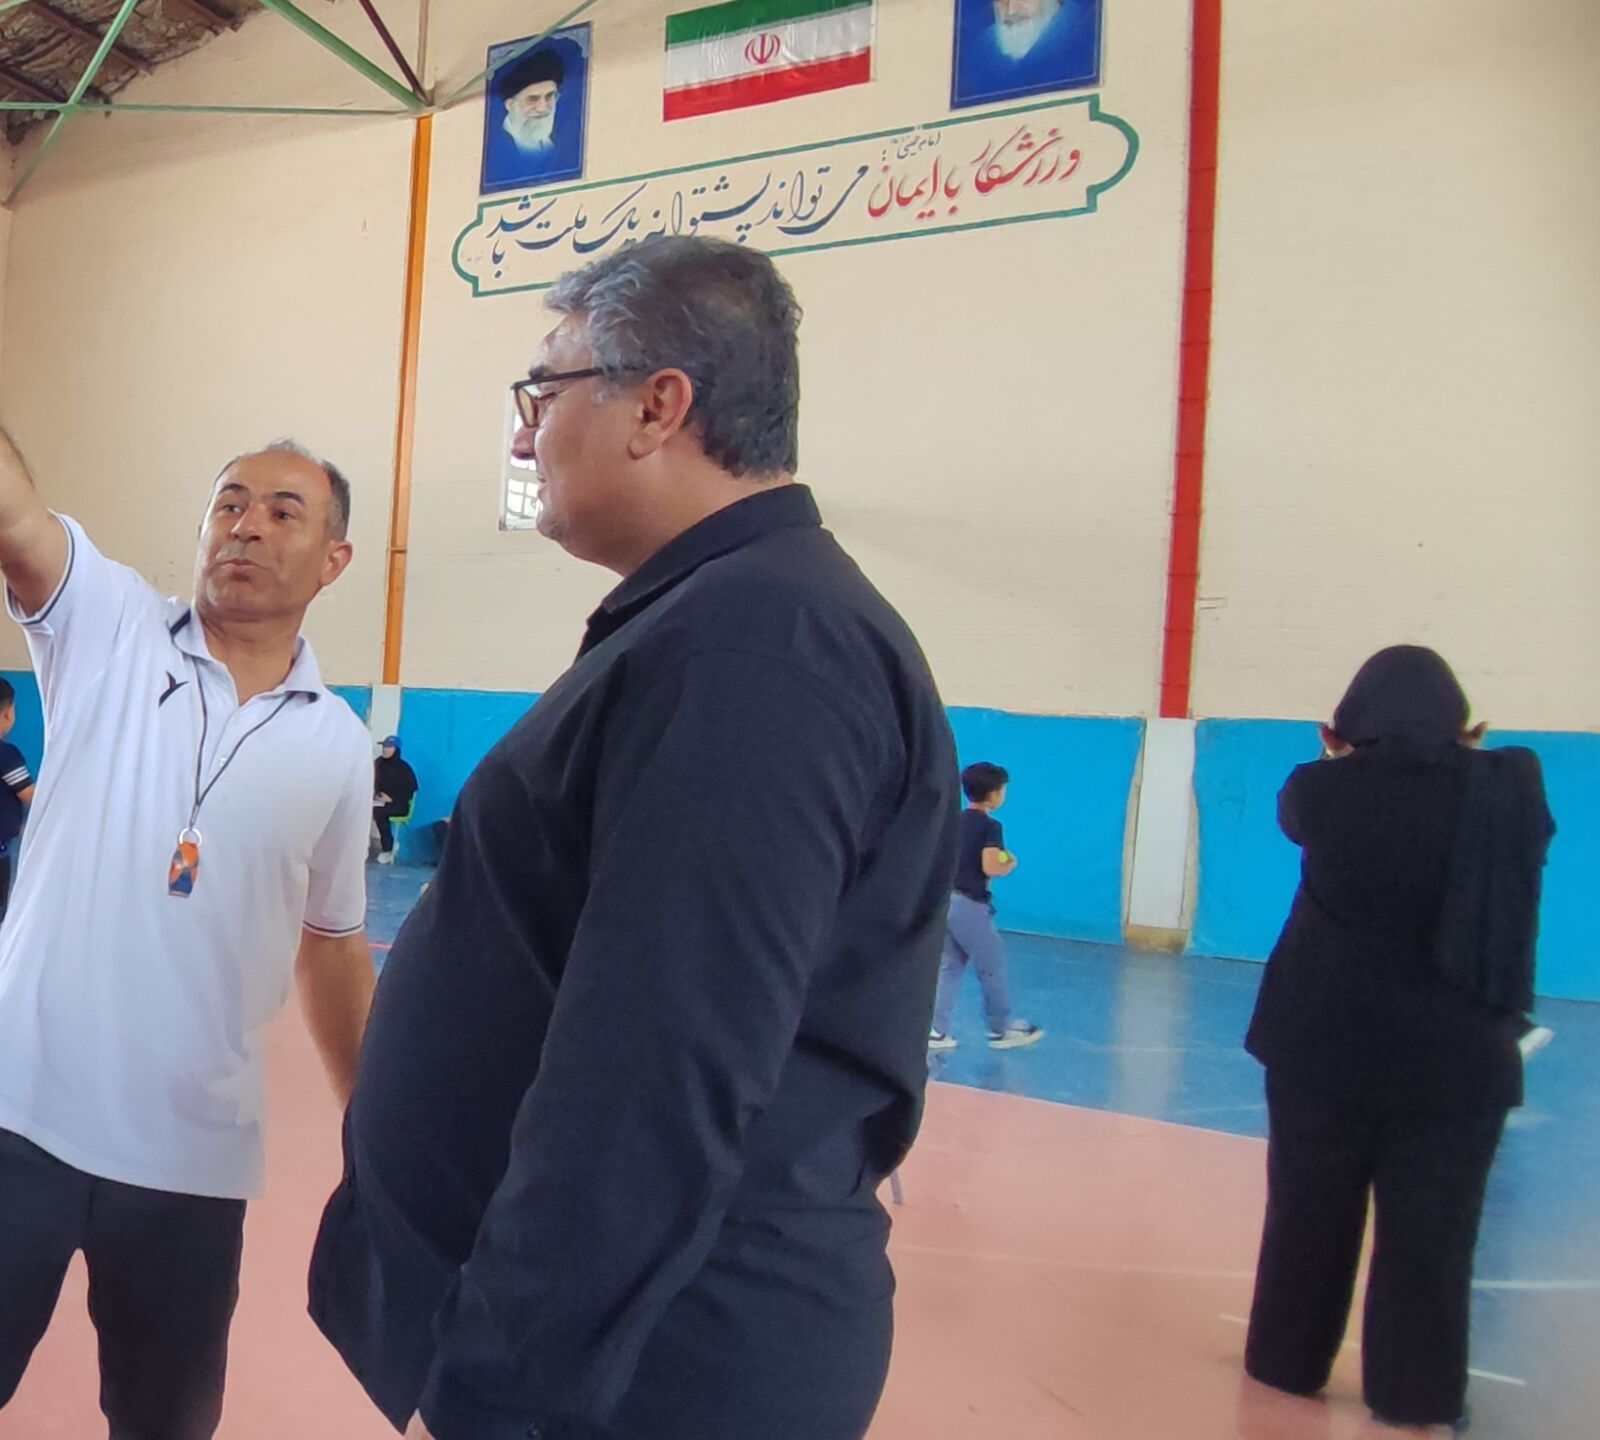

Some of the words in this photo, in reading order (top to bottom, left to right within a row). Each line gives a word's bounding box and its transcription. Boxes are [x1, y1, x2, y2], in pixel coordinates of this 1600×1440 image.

[867, 154, 942, 220] ایمان
[943, 166, 962, 215] با
[971, 124, 1081, 194] ورزشکار
[515, 203, 588, 250] ملت
[776, 164, 870, 235] می
